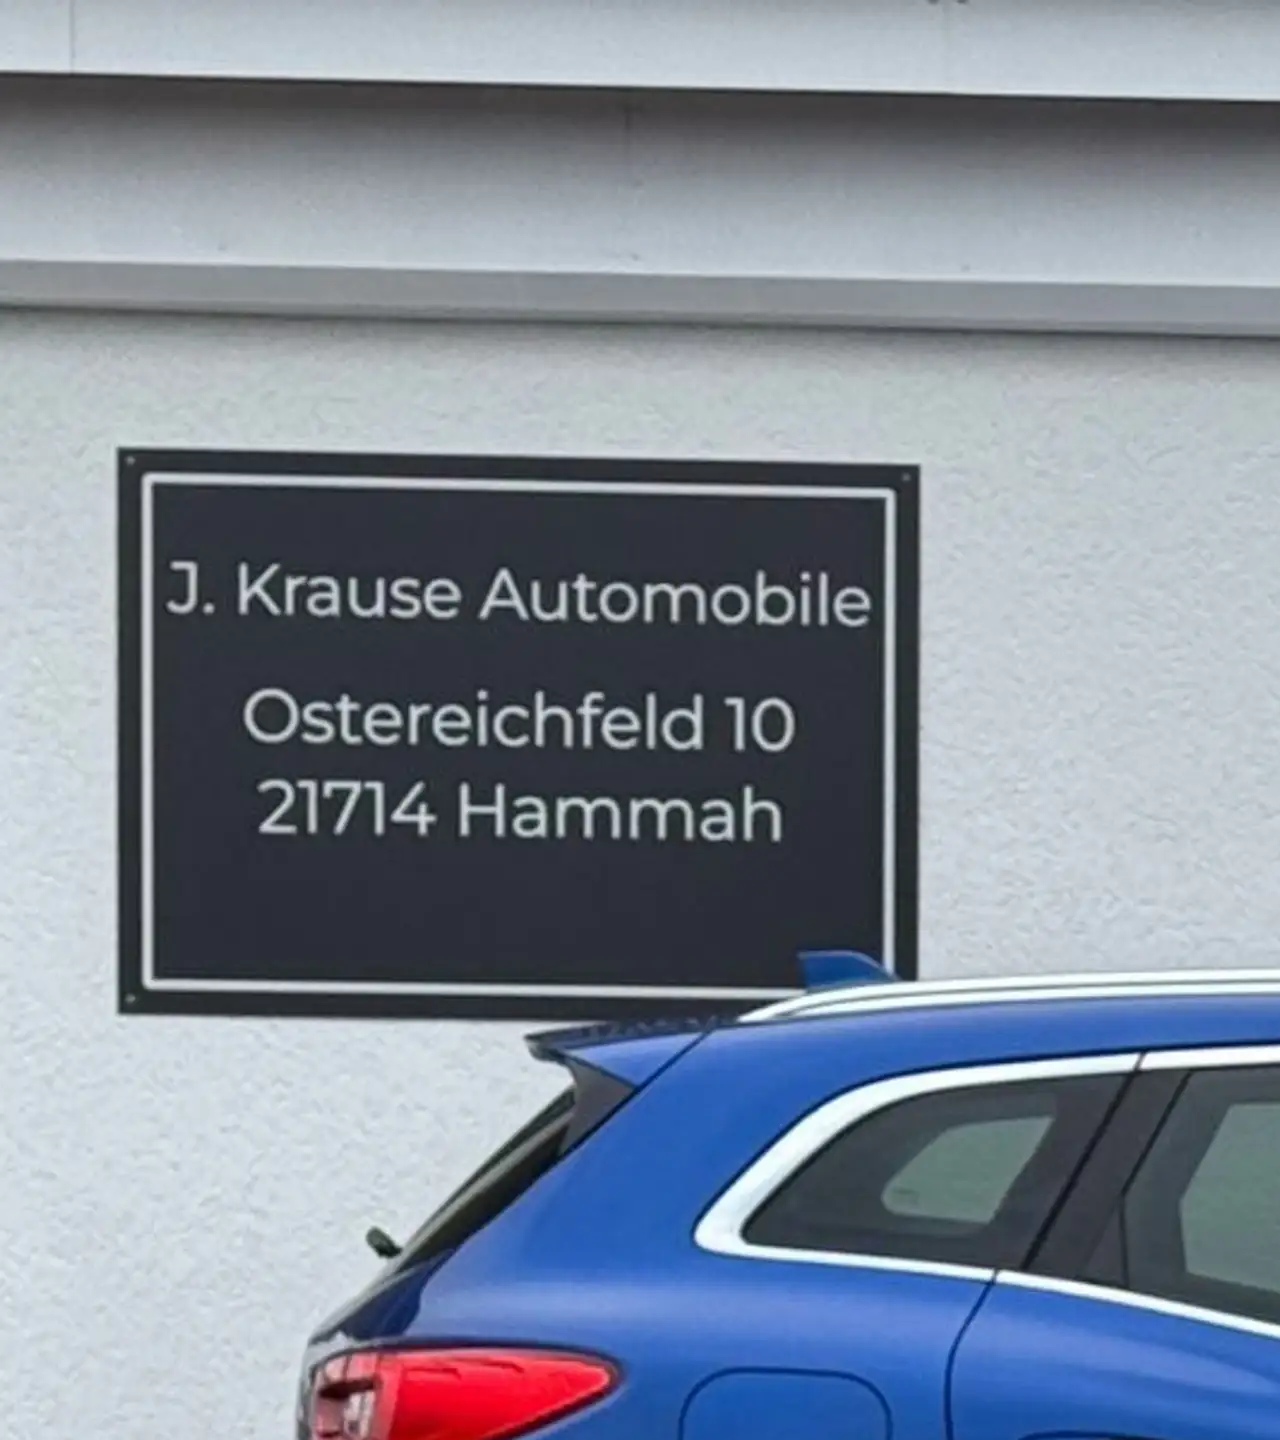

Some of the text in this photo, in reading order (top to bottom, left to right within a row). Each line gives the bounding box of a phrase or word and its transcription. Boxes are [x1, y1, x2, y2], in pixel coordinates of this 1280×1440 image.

[166, 560, 872, 627] J. Krause Automobile
[243, 687, 795, 752] Ostereichfeld 10
[257, 778, 782, 841] 21714 Hammah
